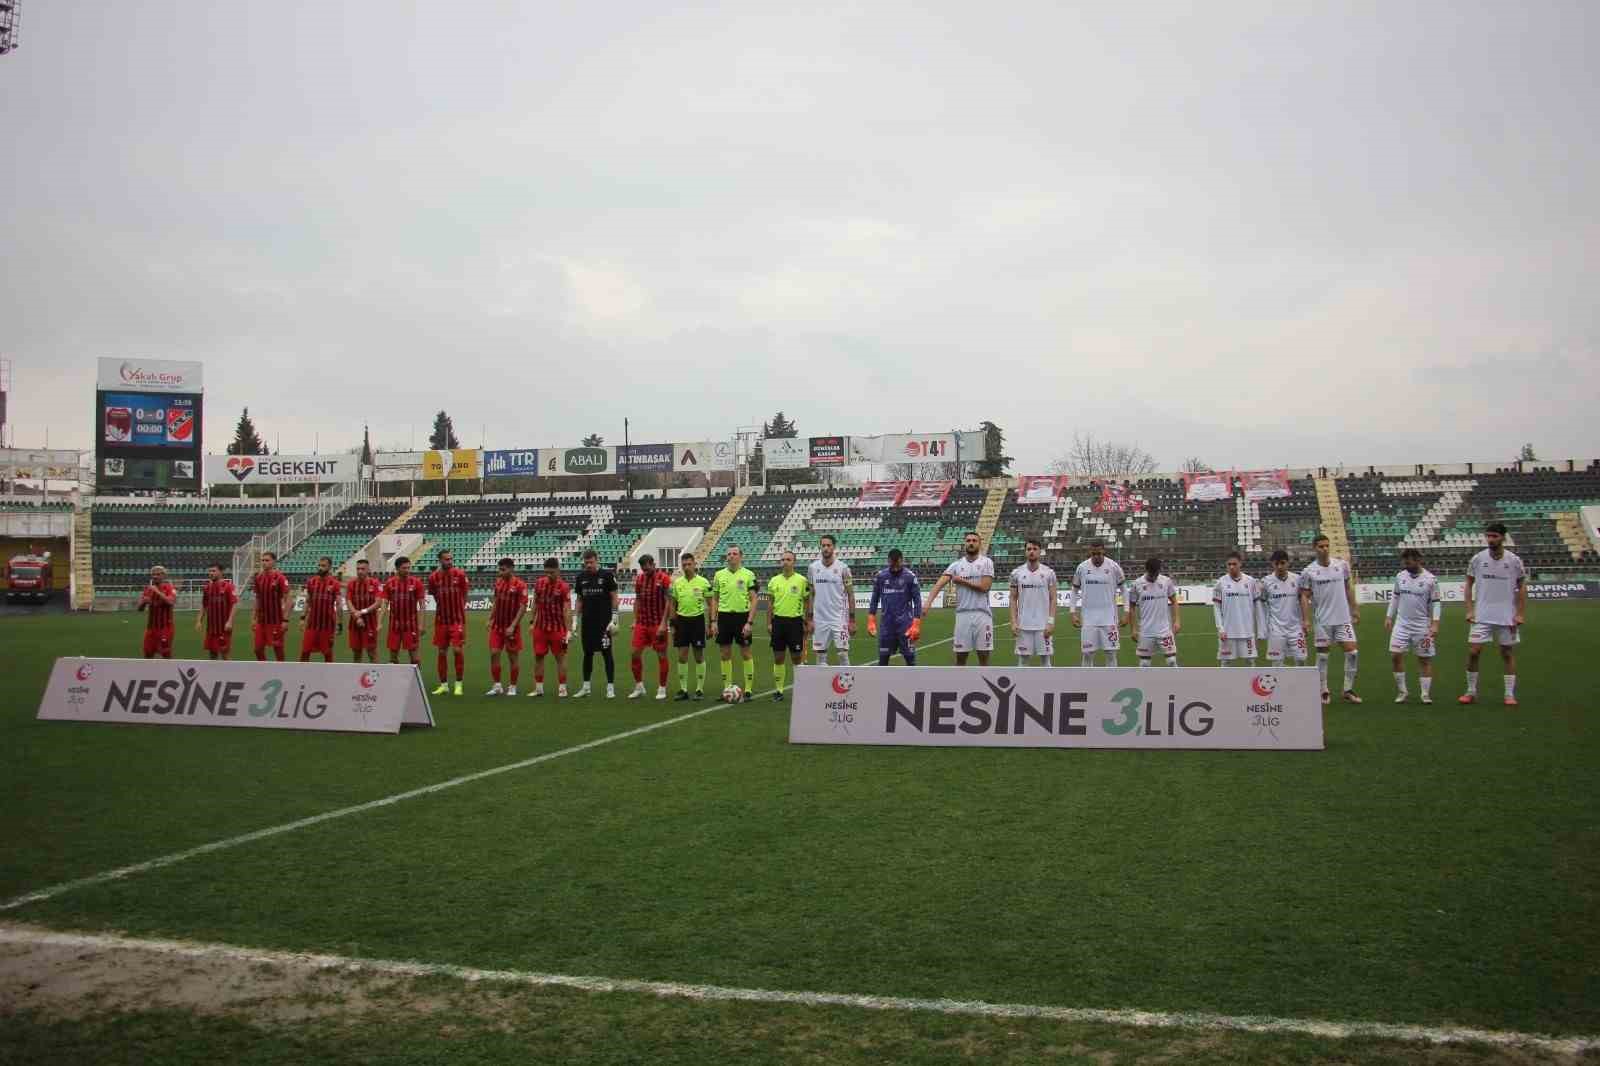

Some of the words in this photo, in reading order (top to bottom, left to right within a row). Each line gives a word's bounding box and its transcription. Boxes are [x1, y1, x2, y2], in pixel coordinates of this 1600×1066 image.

[136, 409, 144, 420] 0
[156, 409, 164, 420] 0
[137, 424, 162, 433] 00:00
[921, 440, 946, 457] T4T
[569, 454, 603, 466] ABALI
[258, 461, 337, 475] EGEKENT
[1527, 584, 1585, 592] RAPINAR
